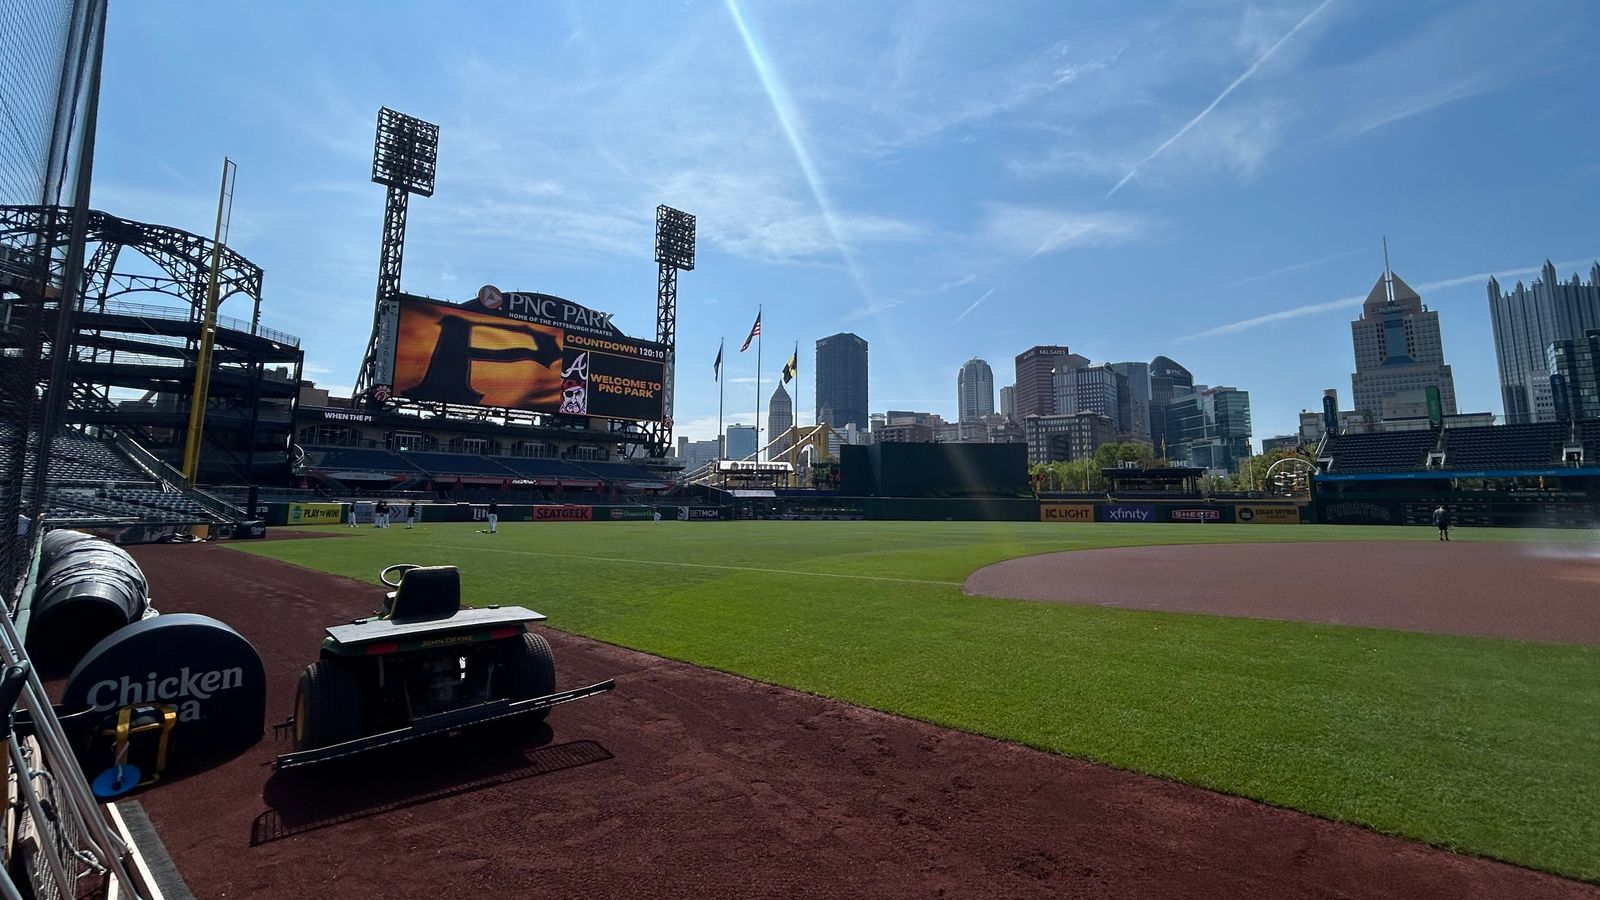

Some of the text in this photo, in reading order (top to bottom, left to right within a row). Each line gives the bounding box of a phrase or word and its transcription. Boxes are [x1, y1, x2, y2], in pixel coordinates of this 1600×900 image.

[508, 292, 615, 331] PNC PARK
[509, 313, 528, 322] HOME
[540, 318, 552, 326] THE
[553, 321, 589, 333] PITTSBURGH
[590, 328, 613, 337] PIRATES
[566, 335, 664, 359] COUNTDOWN 120:10
[590, 373, 661, 391] WELCOME TO
[598, 383, 654, 399] PNC PARK
[324, 412, 349, 420] WHEN
[304, 508, 320, 518] PLAY
[536, 507, 588, 519] SEATGEEK
[690, 509, 719, 518] BETMGM
[1059, 509, 1090, 518] LIGHT
[1109, 507, 1150, 521] xfinity
[86, 666, 244, 712] Chicken
